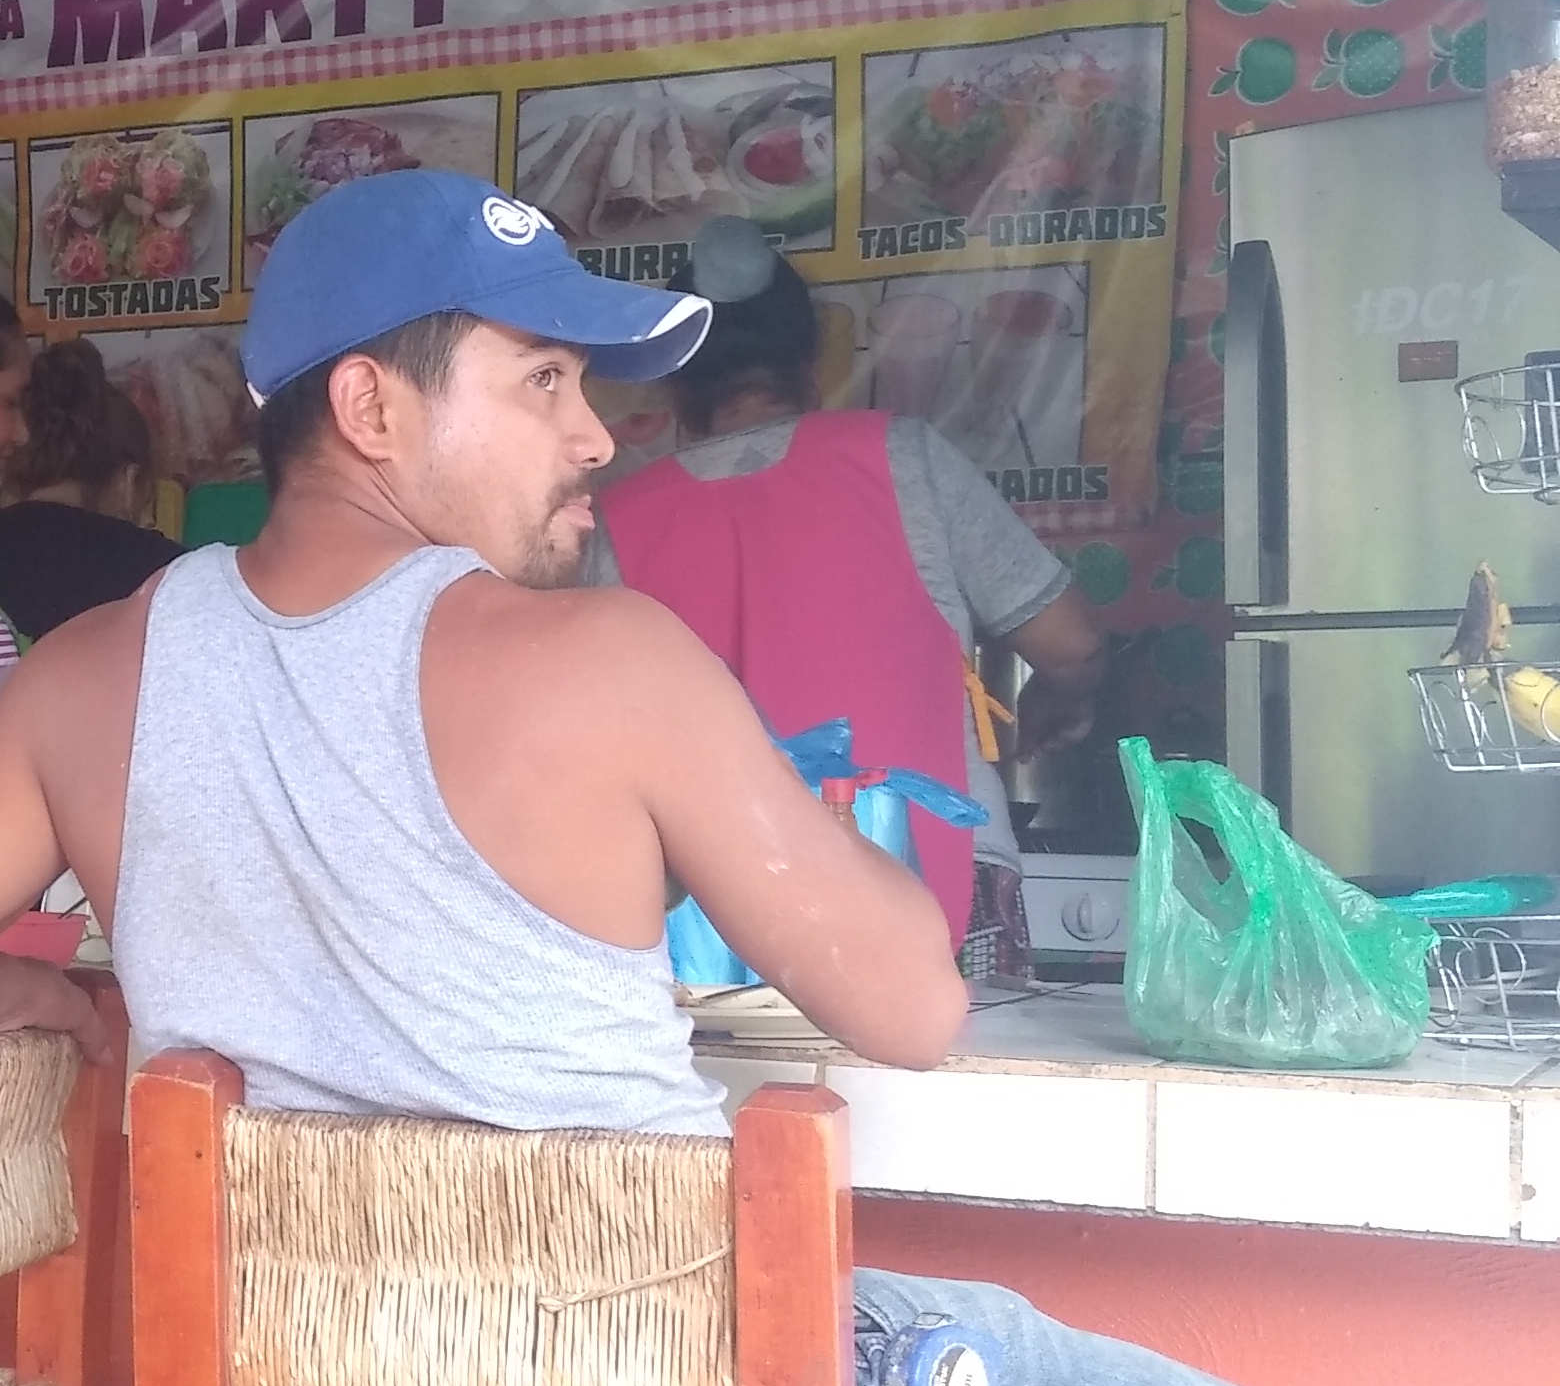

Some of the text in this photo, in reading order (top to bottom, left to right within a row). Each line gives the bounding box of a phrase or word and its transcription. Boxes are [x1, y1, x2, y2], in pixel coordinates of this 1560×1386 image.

[857, 203, 1168, 260] TACOS DORADOS
[43, 276, 222, 321] TOSTADAS
